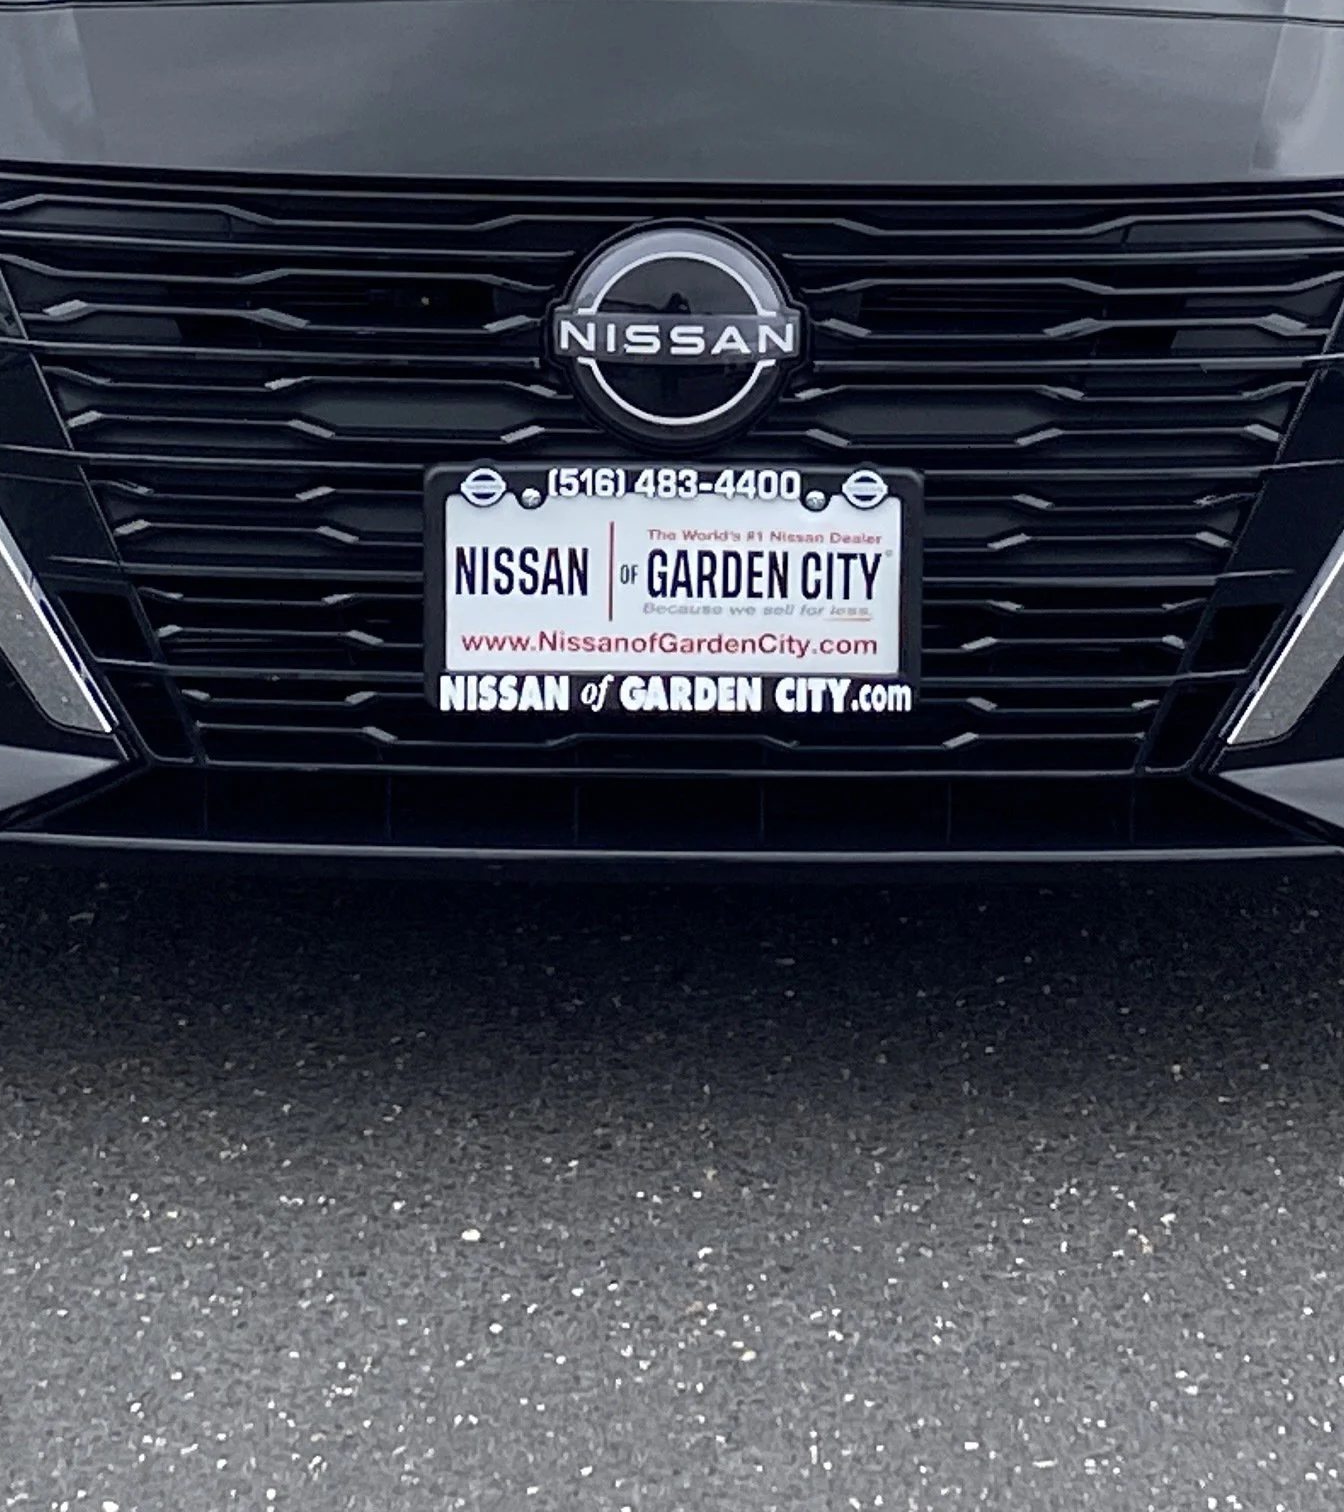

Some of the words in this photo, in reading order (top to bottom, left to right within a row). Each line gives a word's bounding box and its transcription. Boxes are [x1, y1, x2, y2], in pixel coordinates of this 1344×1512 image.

[560, 320, 794, 355] NISSAN
[548, 468, 626, 498] (516)
[635, 469, 801, 500] 483-4400
[647, 529, 677, 542] The
[683, 529, 741, 543] World's
[770, 531, 825, 544] Nissan
[830, 531, 882, 545] Dealer
[456, 546, 589, 596] NISSAN
[620, 564, 639, 585] OF
[647, 548, 789, 599] GARDEN
[801, 551, 882, 600] CITY
[643, 601, 723, 616] Because
[729, 604, 756, 616] we
[462, 630, 877, 658] www.NissanofGardenCity.com
[440, 674, 570, 711] NISSAN
[580, 673, 615, 712] of
[619, 675, 762, 712] GARDEN
[775, 677, 912, 713] CITY.com
